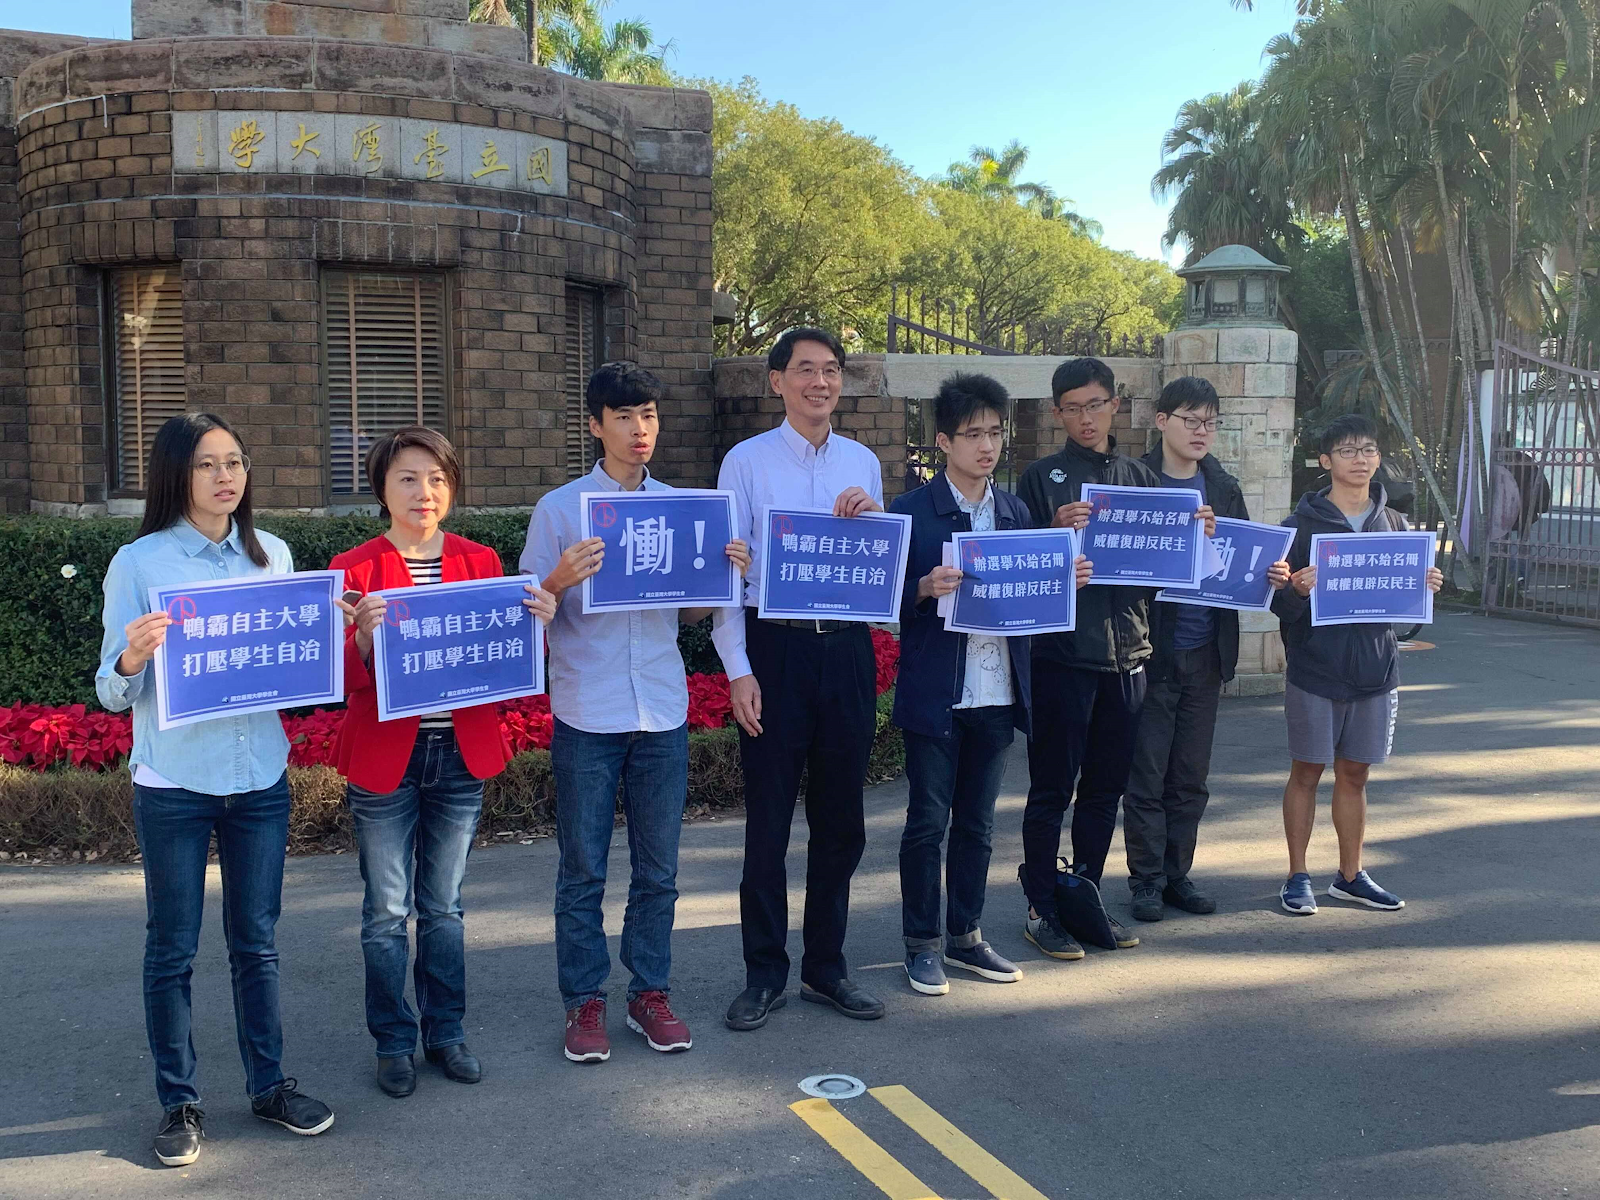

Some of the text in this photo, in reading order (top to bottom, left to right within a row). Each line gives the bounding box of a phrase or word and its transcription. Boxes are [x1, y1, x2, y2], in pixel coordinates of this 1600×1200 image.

[229, 120, 553, 185] 國立臺灣大學
[1096, 508, 1191, 527] 辦選舉不給名冊
[618, 515, 706, 576] 慟！
[781, 533, 890, 558] 鴨霸自主大學
[1093, 533, 1187, 552] 威權復辟反民主
[973, 552, 1065, 572] 辦選舉不給名冊
[1328, 552, 1419, 568] 辦選舉不給名冊
[779, 562, 887, 586] 打壓學生自治
[1326, 575, 1418, 592] 威權復辟反民主
[971, 578, 1063, 599] 威權復辟反民主
[182, 603, 321, 641] 鴨霸自主大學
[399, 605, 524, 641] 鴨霸自主大學
[182, 638, 321, 678] 打壓學生自治
[401, 637, 524, 675] 打壓學生自治
